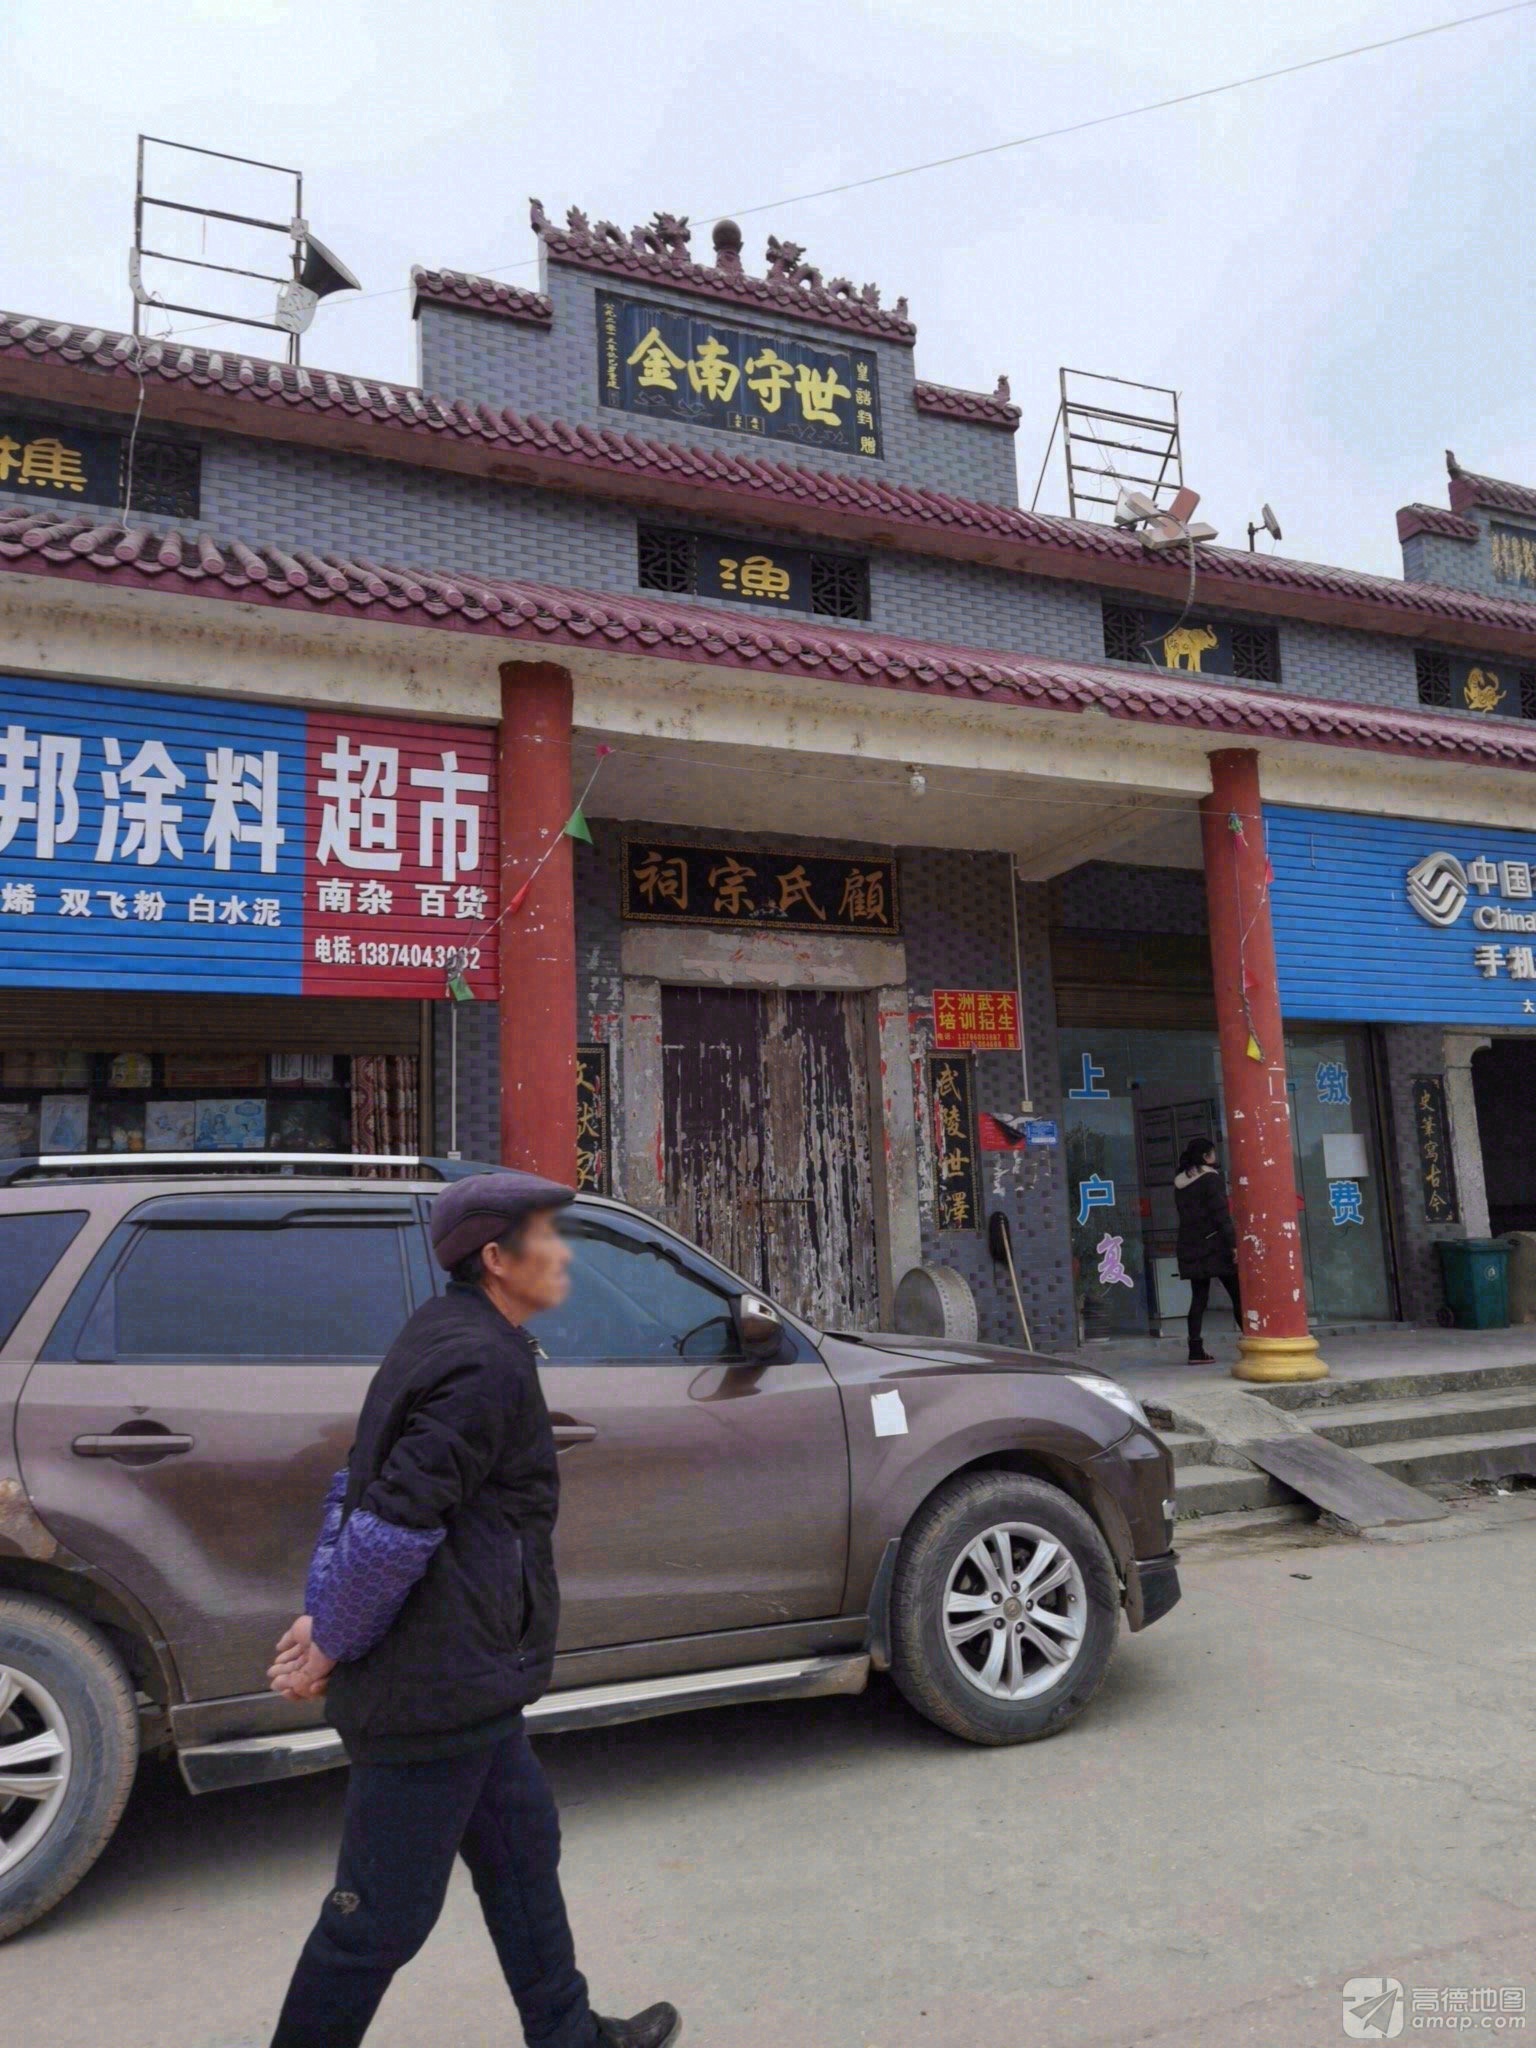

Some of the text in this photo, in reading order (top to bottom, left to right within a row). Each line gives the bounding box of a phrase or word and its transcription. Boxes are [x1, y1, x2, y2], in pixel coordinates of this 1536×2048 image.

[0, 725, 285, 873] 邦涂料
[316, 735, 489, 882] 超市
[1467, 855, 1536, 898] 中国
[1, 882, 282, 927] 烯 双飞粉 白水泥
[316, 878, 489, 920] 南杂 百货
[938, 992, 1014, 1012] 大洲武术
[939, 1011, 1015, 1031] 培训招生
